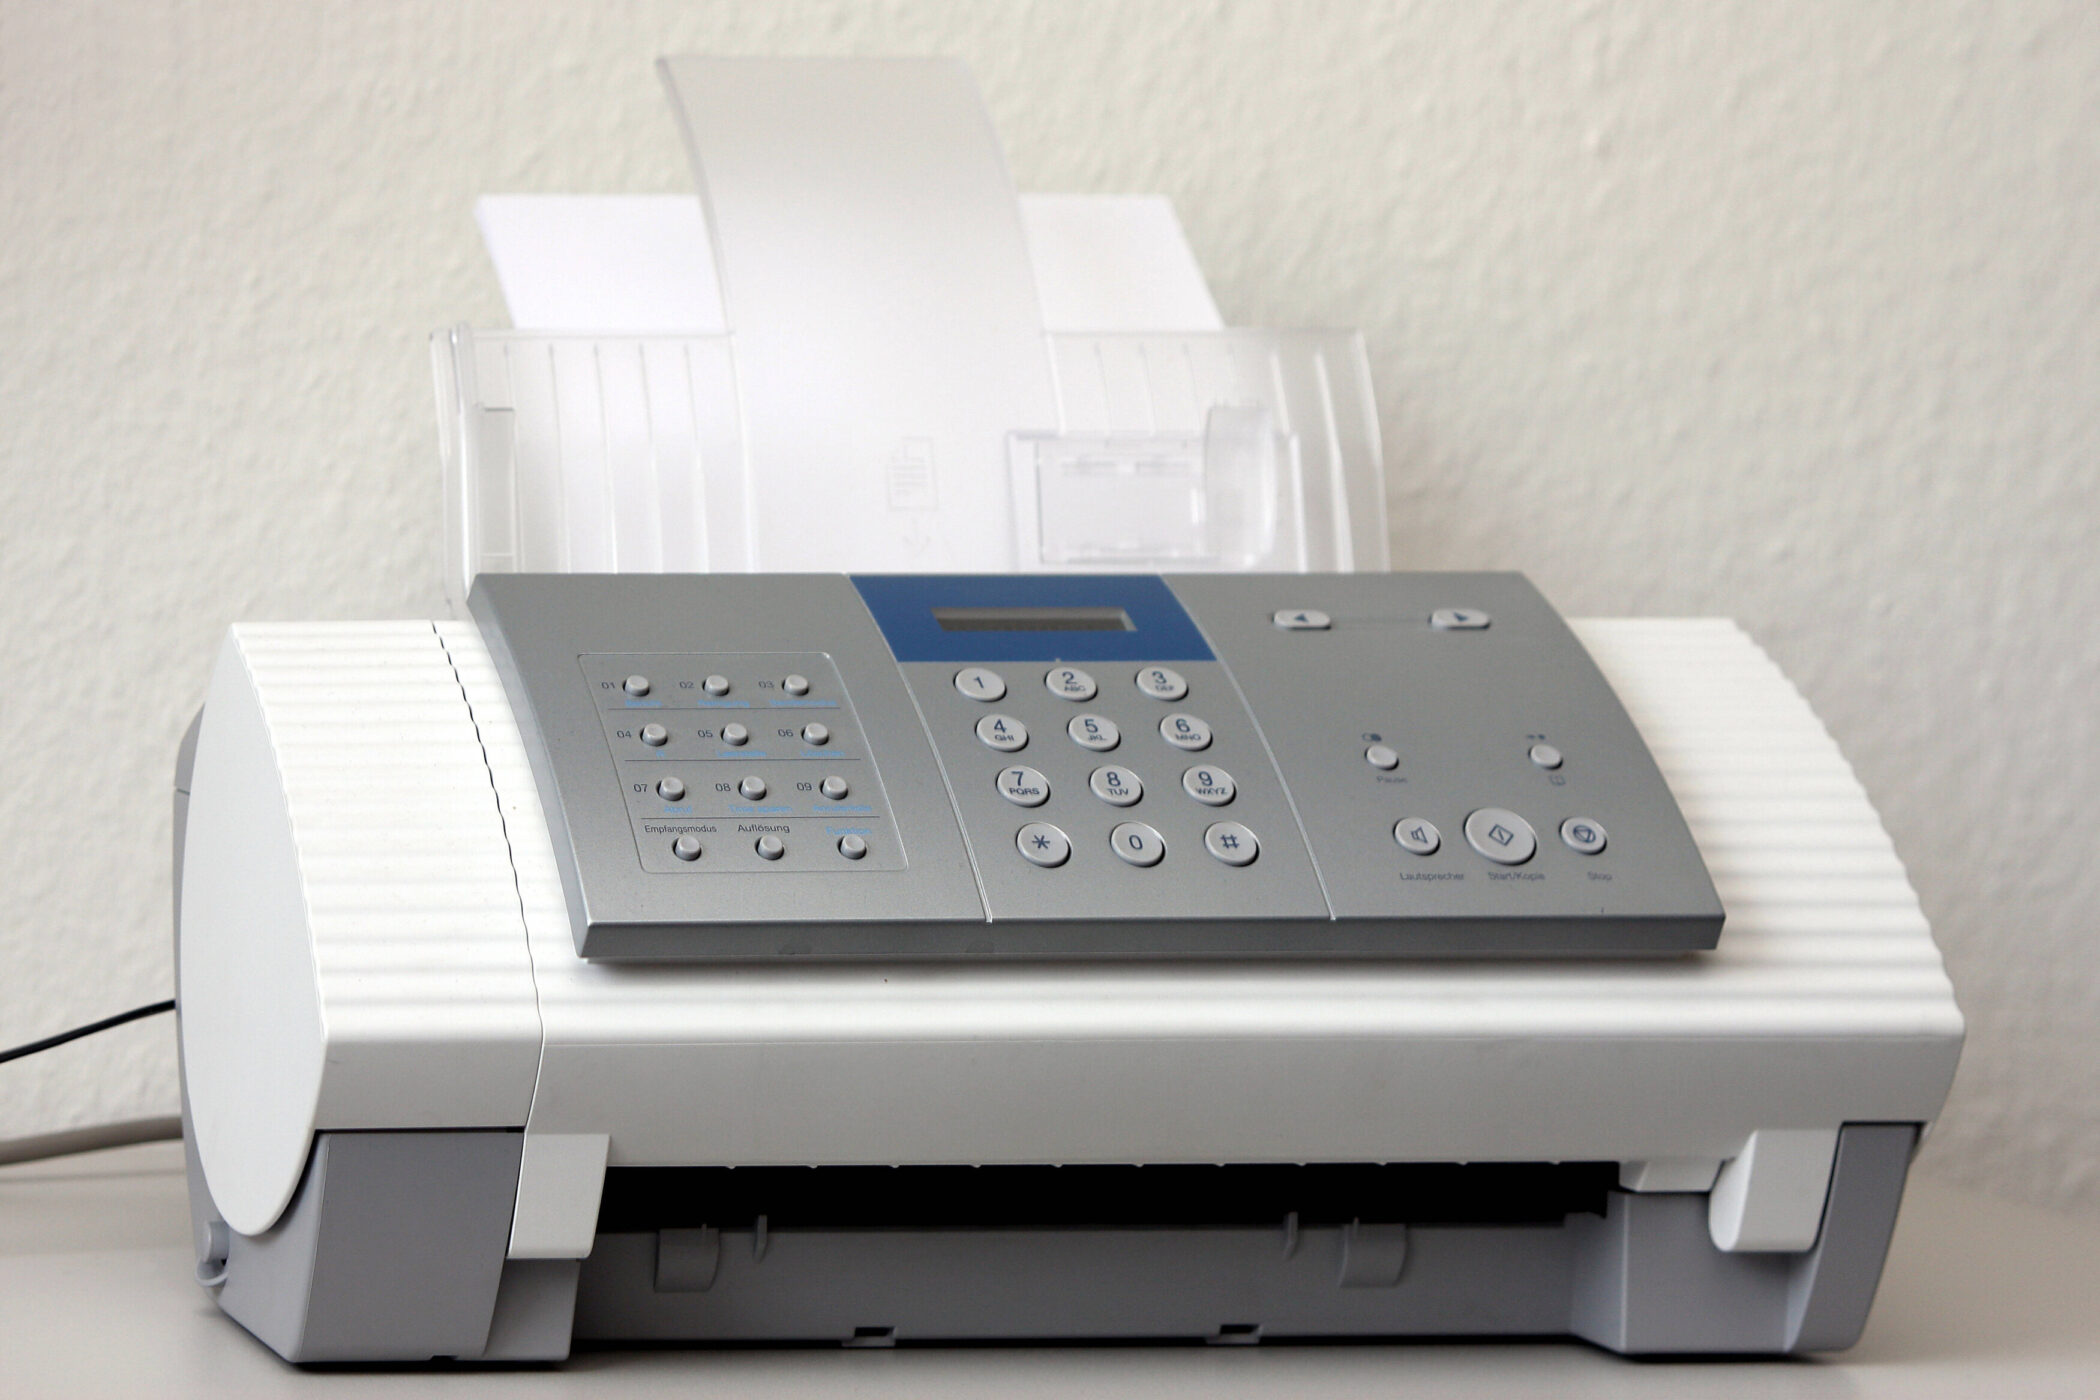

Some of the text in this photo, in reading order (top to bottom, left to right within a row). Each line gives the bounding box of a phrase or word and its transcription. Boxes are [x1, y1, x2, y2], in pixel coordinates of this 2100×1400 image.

[974, 676, 985, 689] 1
[1062, 671, 1077, 685] 2
[1152, 670, 1168, 685] 3
[601, 681, 615, 690] 01
[679, 681, 695, 689] 02
[758, 680, 775, 689] 03
[993, 718, 1007, 733] 4
[1084, 718, 1099, 733] 5
[1175, 718, 1191, 733] 6
[616, 730, 632, 739] 04
[697, 729, 713, 738] 05
[777, 728, 794, 737] 06
[1174, 733, 1202, 742] MNO
[994, 734, 1015, 742] GHI
[1011, 770, 1024, 786] 7
[1106, 771, 1121, 787] 8
[1198, 771, 1213, 787] 9
[633, 783, 649, 793] 07
[715, 783, 731, 792] 08
[796, 782, 813, 791] 09
[1008, 787, 1040, 795] PQRS
[1107, 787, 1129, 796] TUV
[1195, 787, 1228, 795] WXYZ
[644, 825, 718, 835] Empfangsmodus
[737, 824, 791, 834] Auflösung
[825, 826, 873, 835] Funktion
[1128, 834, 1143, 850] 0
[1399, 871, 1465, 882] Lautsprecher
[1488, 871, 1546, 882] Start/Kopie
